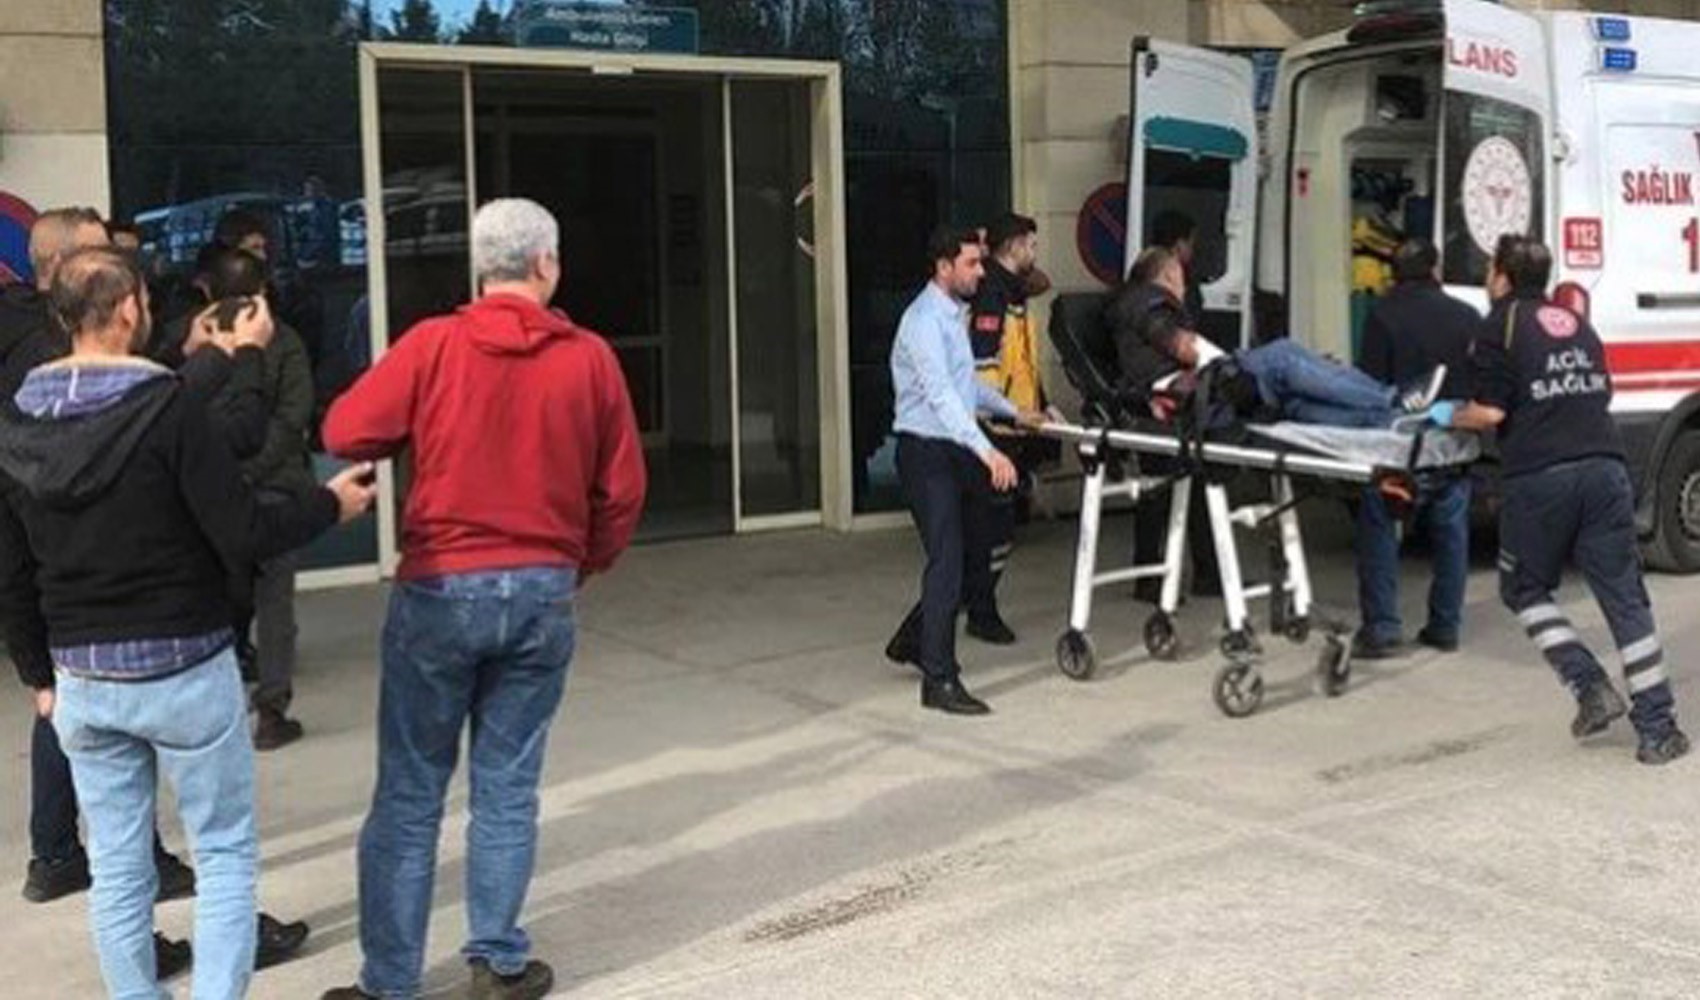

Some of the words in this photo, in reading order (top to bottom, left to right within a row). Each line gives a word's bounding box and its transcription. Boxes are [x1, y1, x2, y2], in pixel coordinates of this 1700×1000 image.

[1448, 38, 1517, 78] LANS
[1621, 165, 1694, 206] SAĞLIK
[1570, 223, 1598, 247] 112
